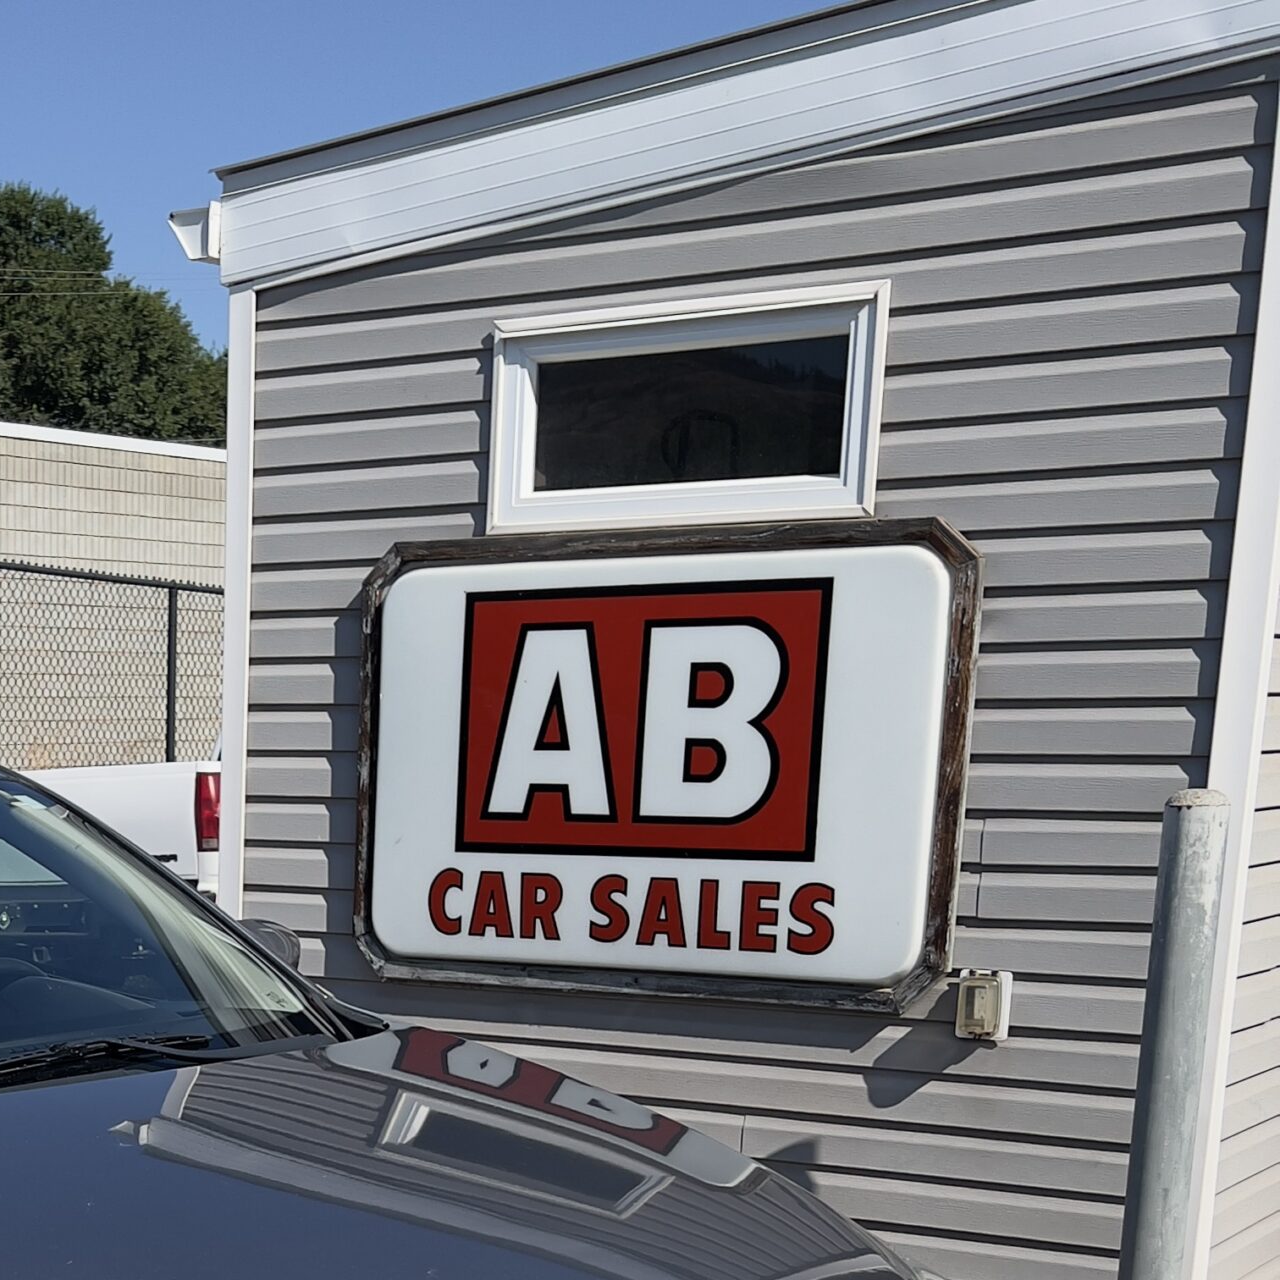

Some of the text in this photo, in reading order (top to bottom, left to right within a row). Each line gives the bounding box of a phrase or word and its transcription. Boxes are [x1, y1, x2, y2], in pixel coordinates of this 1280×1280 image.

[480, 616, 789, 826] AB
[428, 867, 835, 955] CAR SALES
